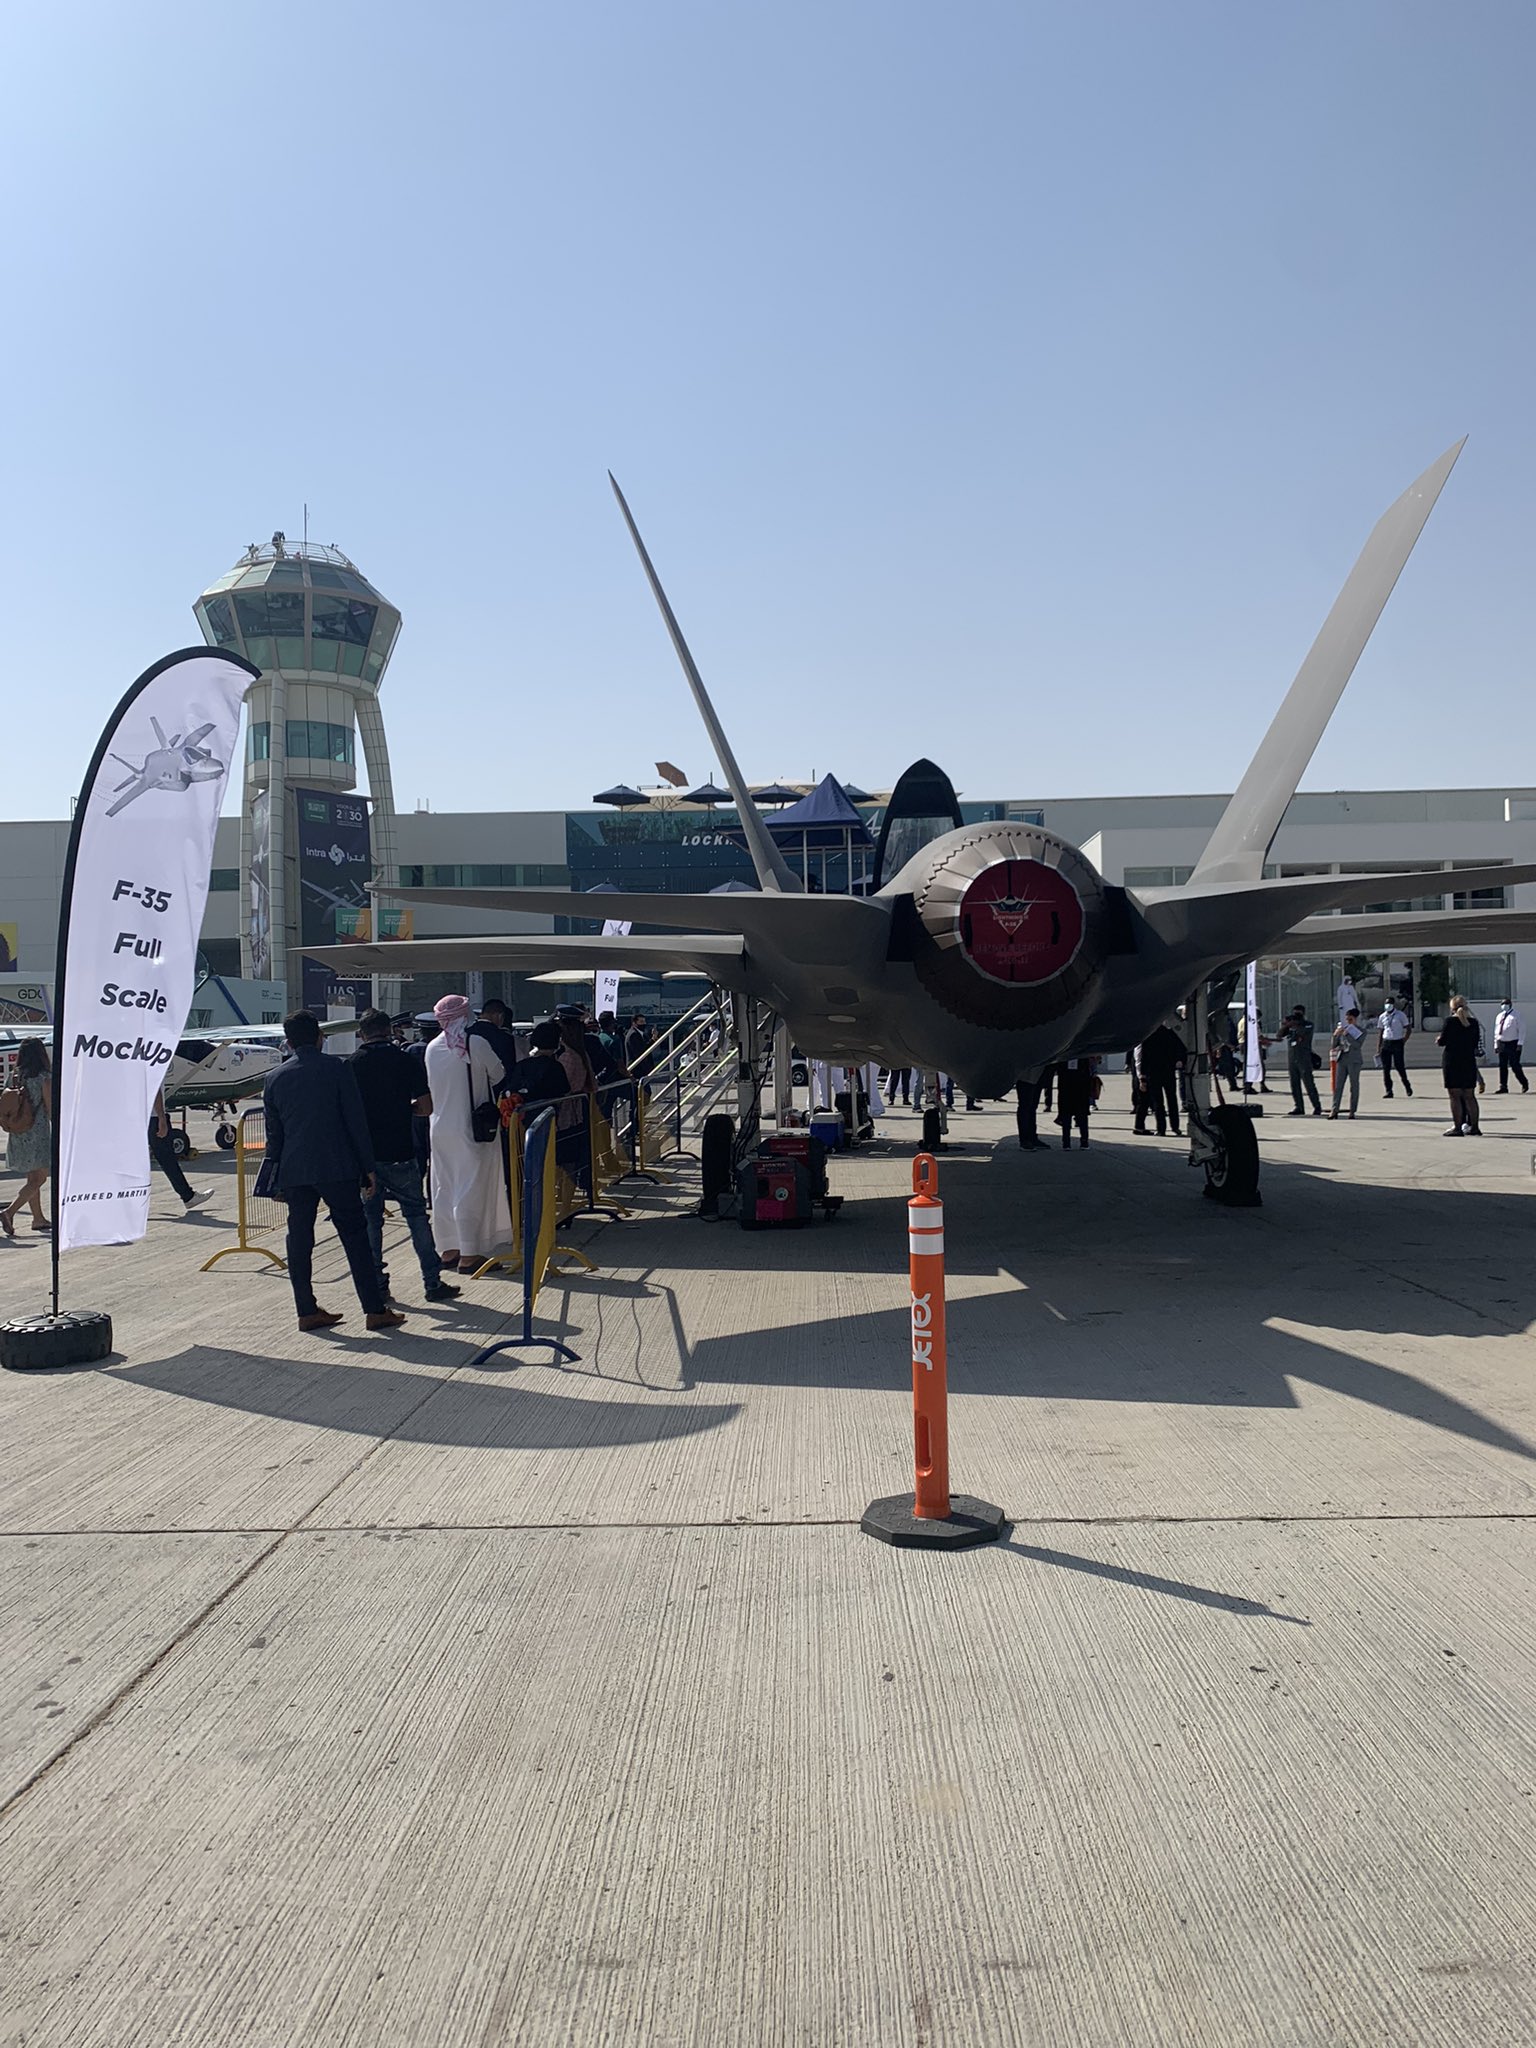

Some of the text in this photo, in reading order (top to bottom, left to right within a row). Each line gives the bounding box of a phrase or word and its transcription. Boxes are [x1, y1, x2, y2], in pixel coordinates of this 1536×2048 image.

[306, 847, 326, 858] Intra
[681, 835, 733, 846] LOCK
[112, 880, 172, 913] F-35
[113, 932, 162, 959] Full
[604, 977, 617, 987] F-35
[100, 983, 167, 1013] Scale
[73, 1034, 172, 1066] MockUp
[911, 1290, 933, 1371] JETEX
